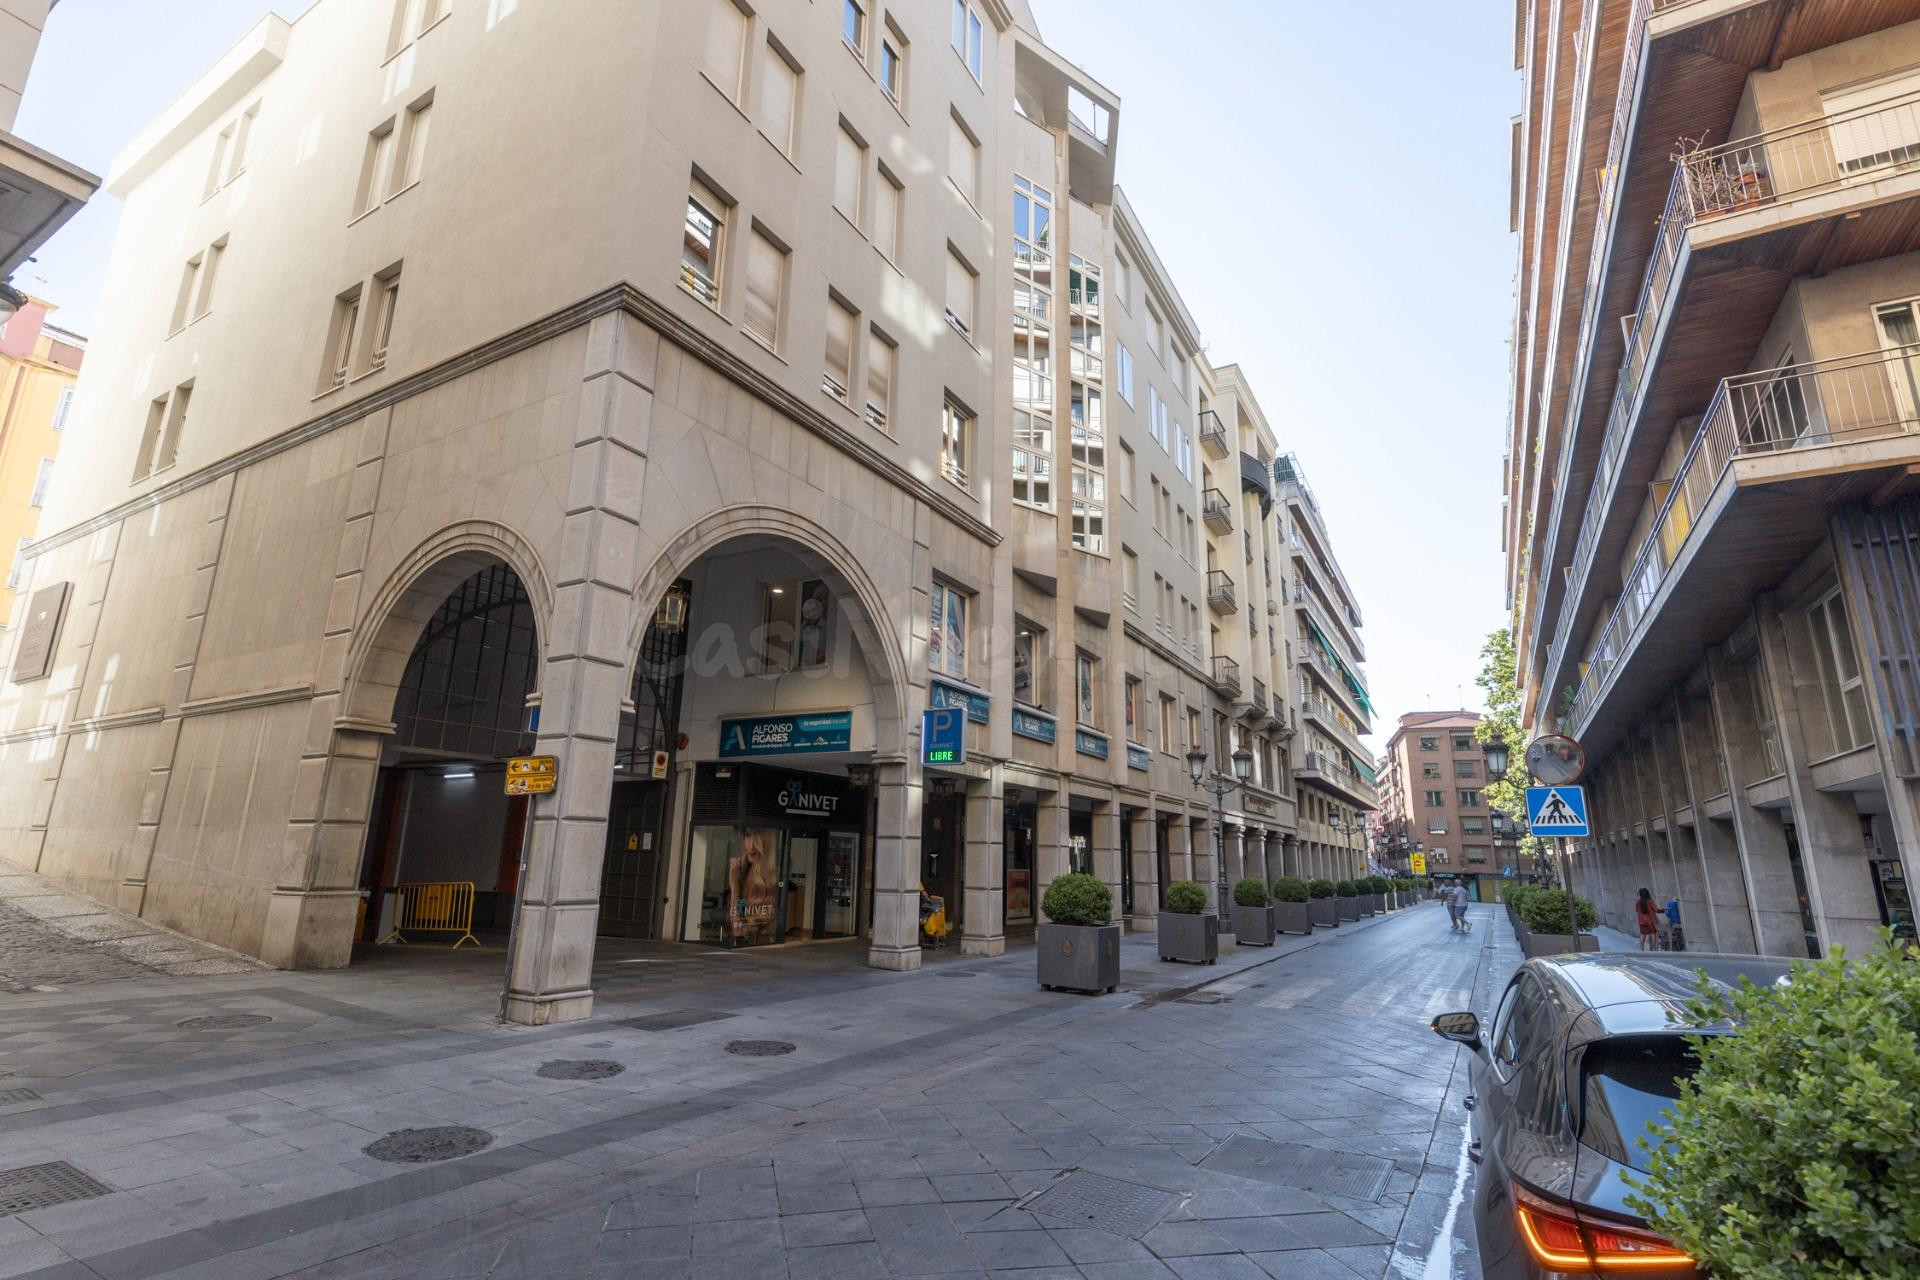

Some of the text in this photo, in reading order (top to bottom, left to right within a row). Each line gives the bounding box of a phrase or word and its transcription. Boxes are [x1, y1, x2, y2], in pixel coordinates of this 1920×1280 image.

[752, 723, 793, 735] ALFONSO
[932, 711, 953, 742] P
[751, 733, 788, 744] FIGARES
[930, 751, 953, 761] LIBRE
